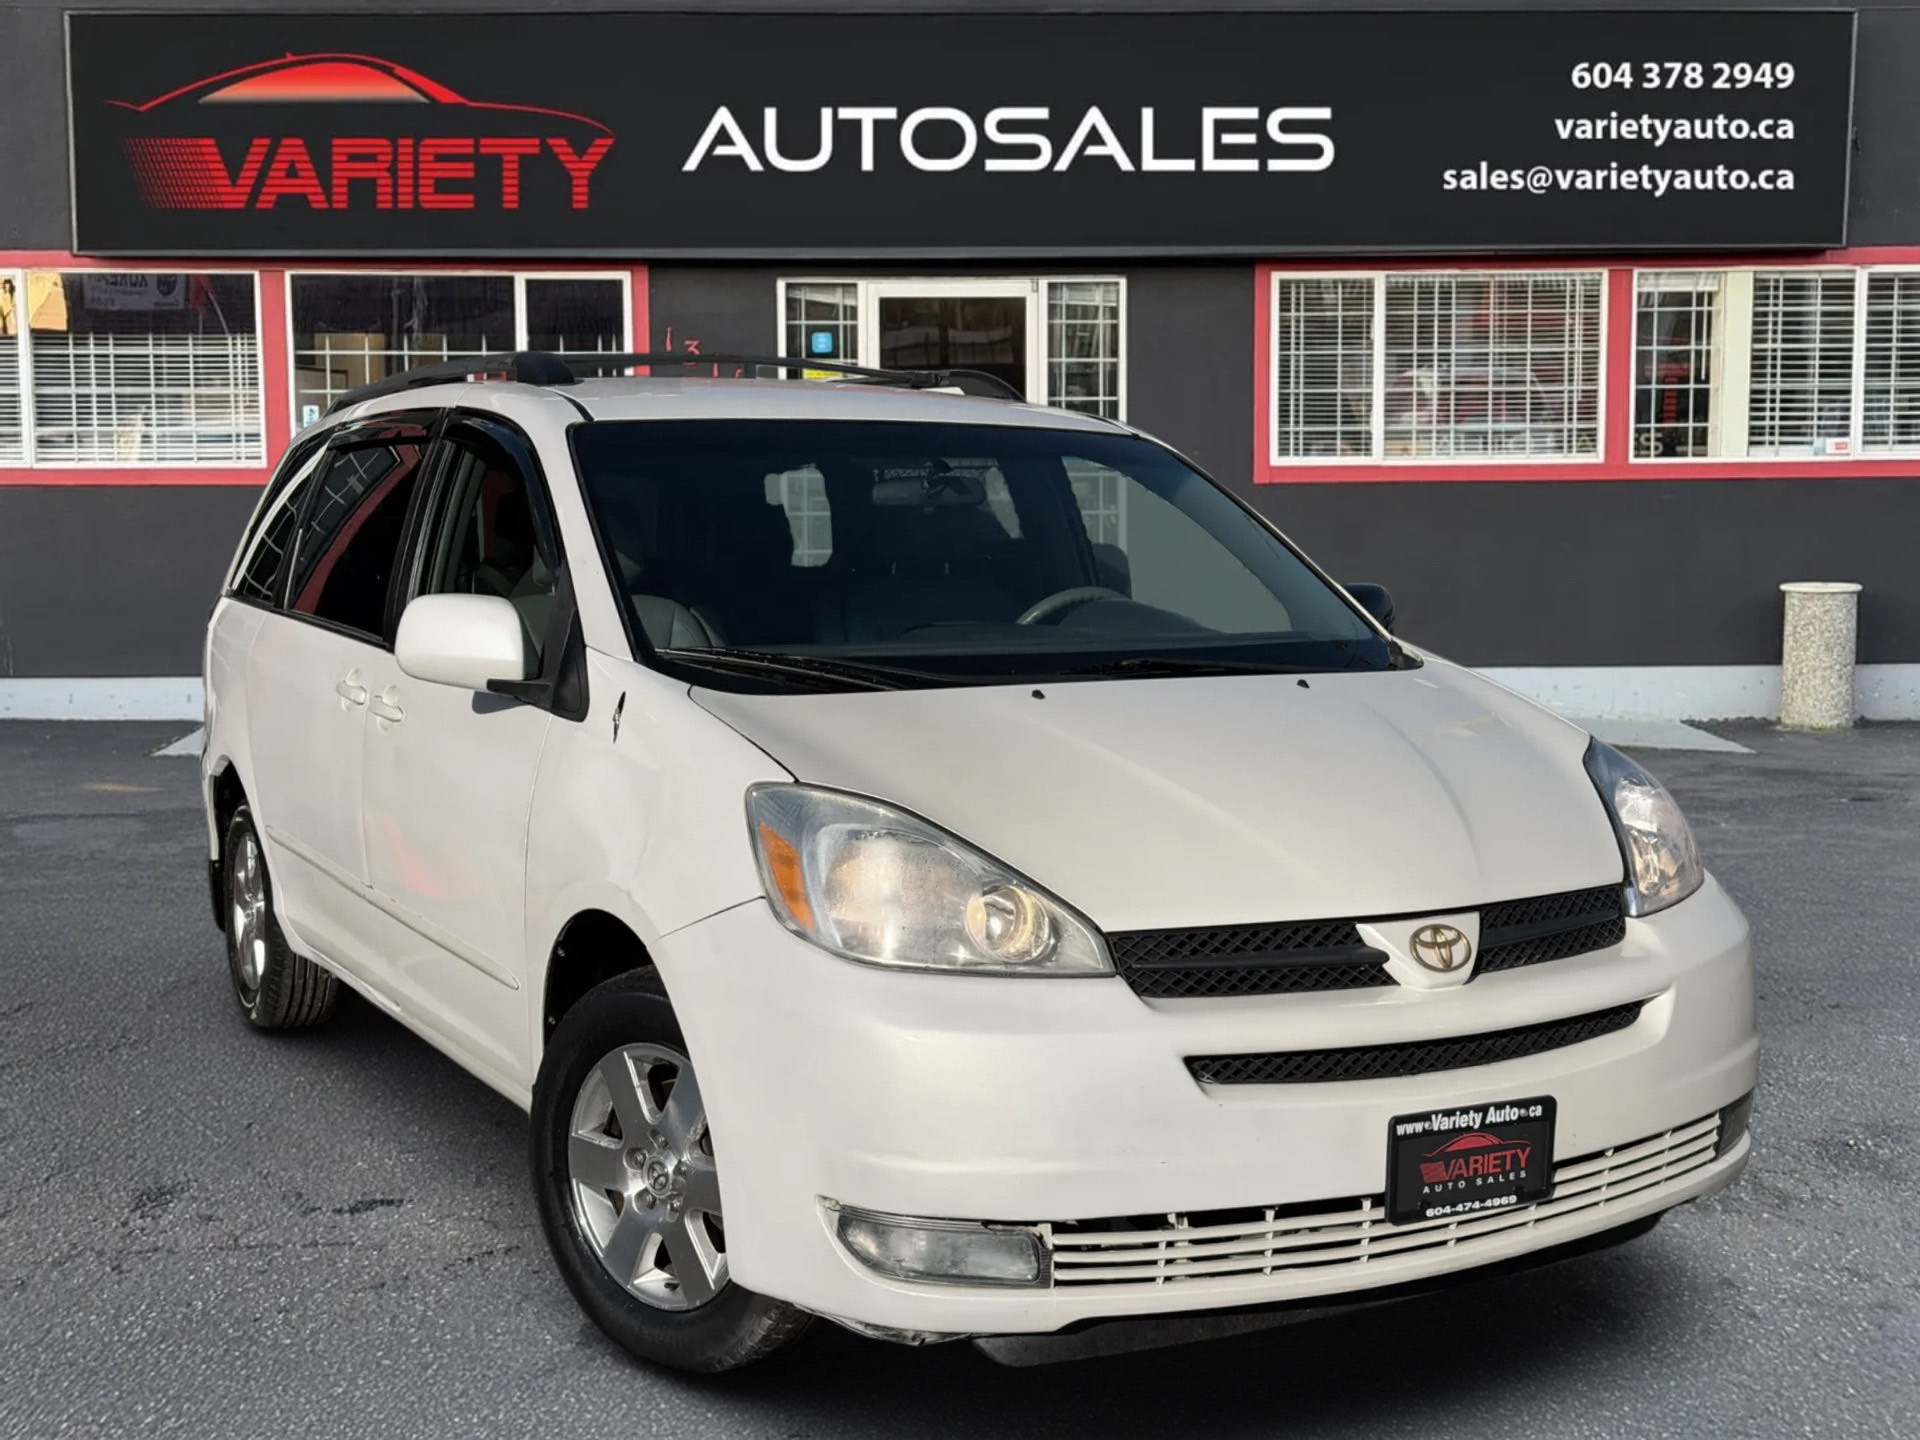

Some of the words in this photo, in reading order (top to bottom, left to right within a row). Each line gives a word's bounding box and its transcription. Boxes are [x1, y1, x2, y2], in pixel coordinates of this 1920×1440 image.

[1571, 61, 1633, 89] 604
[1643, 61, 1704, 89] 378
[1712, 61, 1795, 89] 2949
[682, 105, 1335, 172] AUTOSALES
[1554, 112, 1795, 148] varietyauto.ca
[130, 136, 615, 210] VARIETY
[1443, 161, 1795, 198] sales@varietyauto.ca
[1420, 1146, 1531, 1183] VARIETY
[1423, 1180, 1466, 1194] AUTO
[1475, 1170, 1526, 1186] SALES
[1425, 1195, 1518, 1217] 604-474-4969
